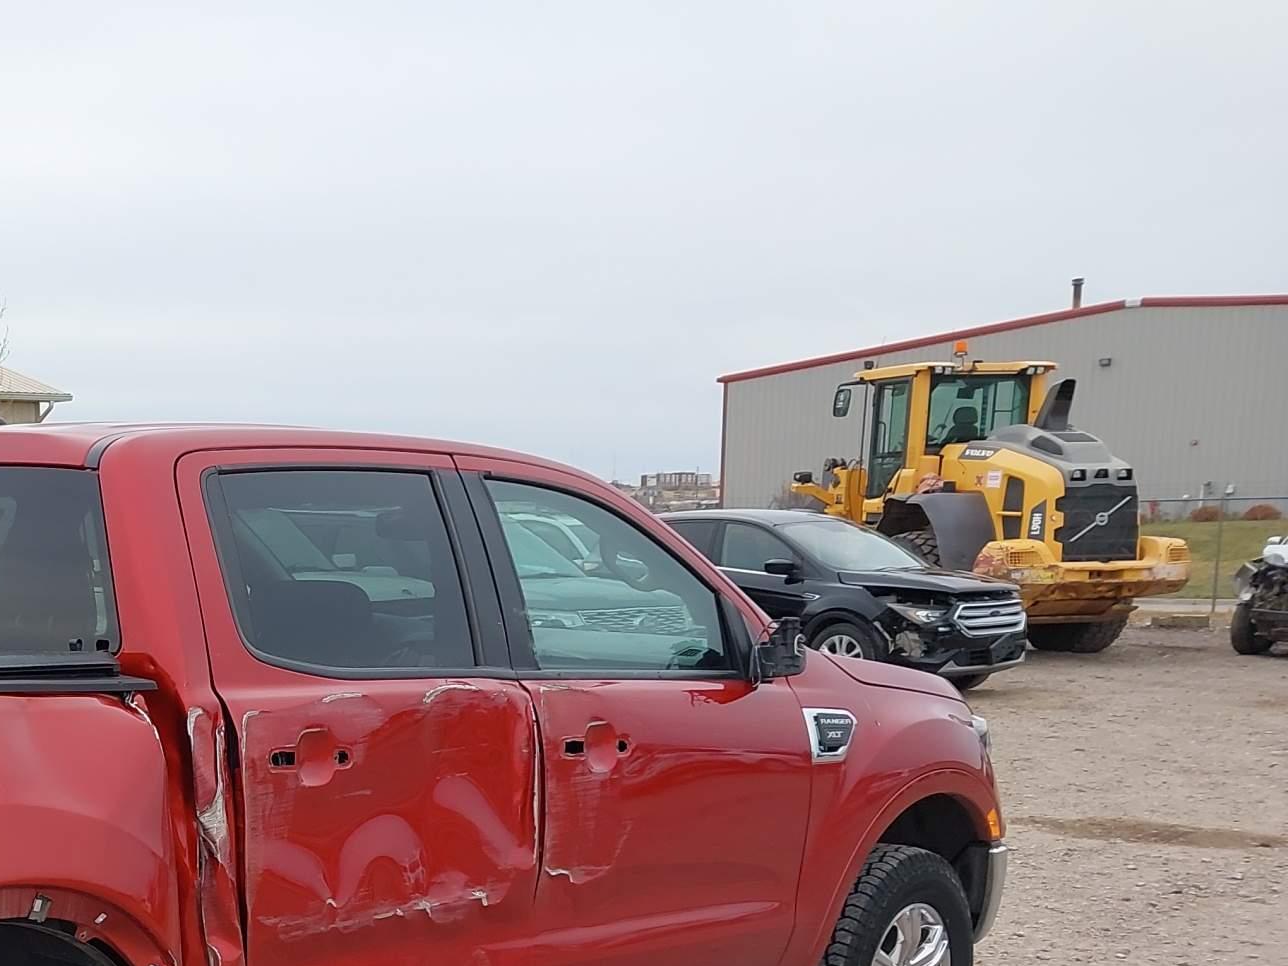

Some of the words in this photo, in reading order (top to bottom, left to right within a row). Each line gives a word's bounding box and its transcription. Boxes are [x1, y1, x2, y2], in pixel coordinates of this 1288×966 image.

[964, 449, 994, 457] VOLVO
[1030, 513, 1043, 535] L90H
[826, 730, 844, 738] XLT
